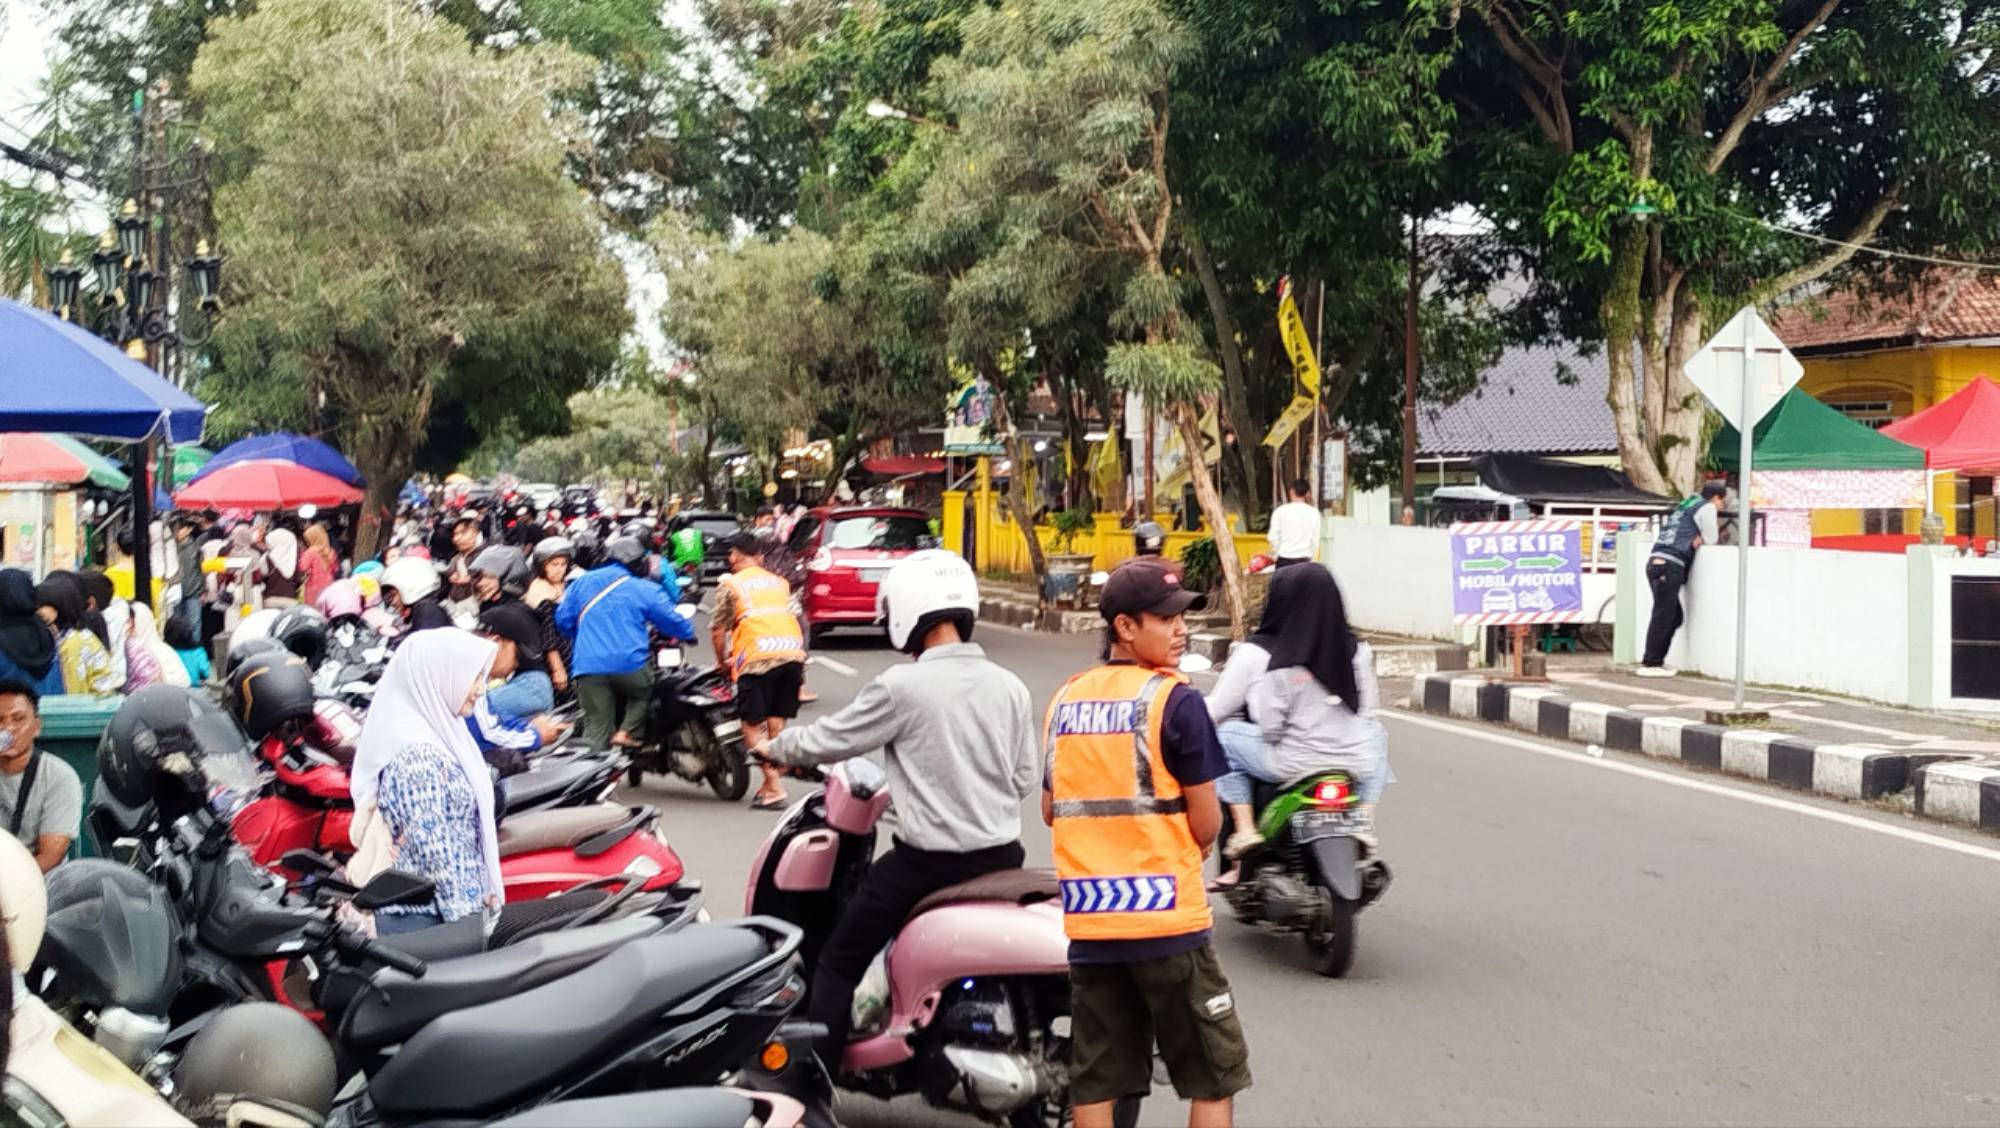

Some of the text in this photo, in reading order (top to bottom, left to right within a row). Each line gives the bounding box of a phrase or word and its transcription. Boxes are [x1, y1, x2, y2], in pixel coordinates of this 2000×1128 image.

[1465, 534, 1566, 554] PARKIR
[1459, 572, 1576, 590] MOBIL/MOTOR
[1058, 701, 1133, 734] PARKIR
